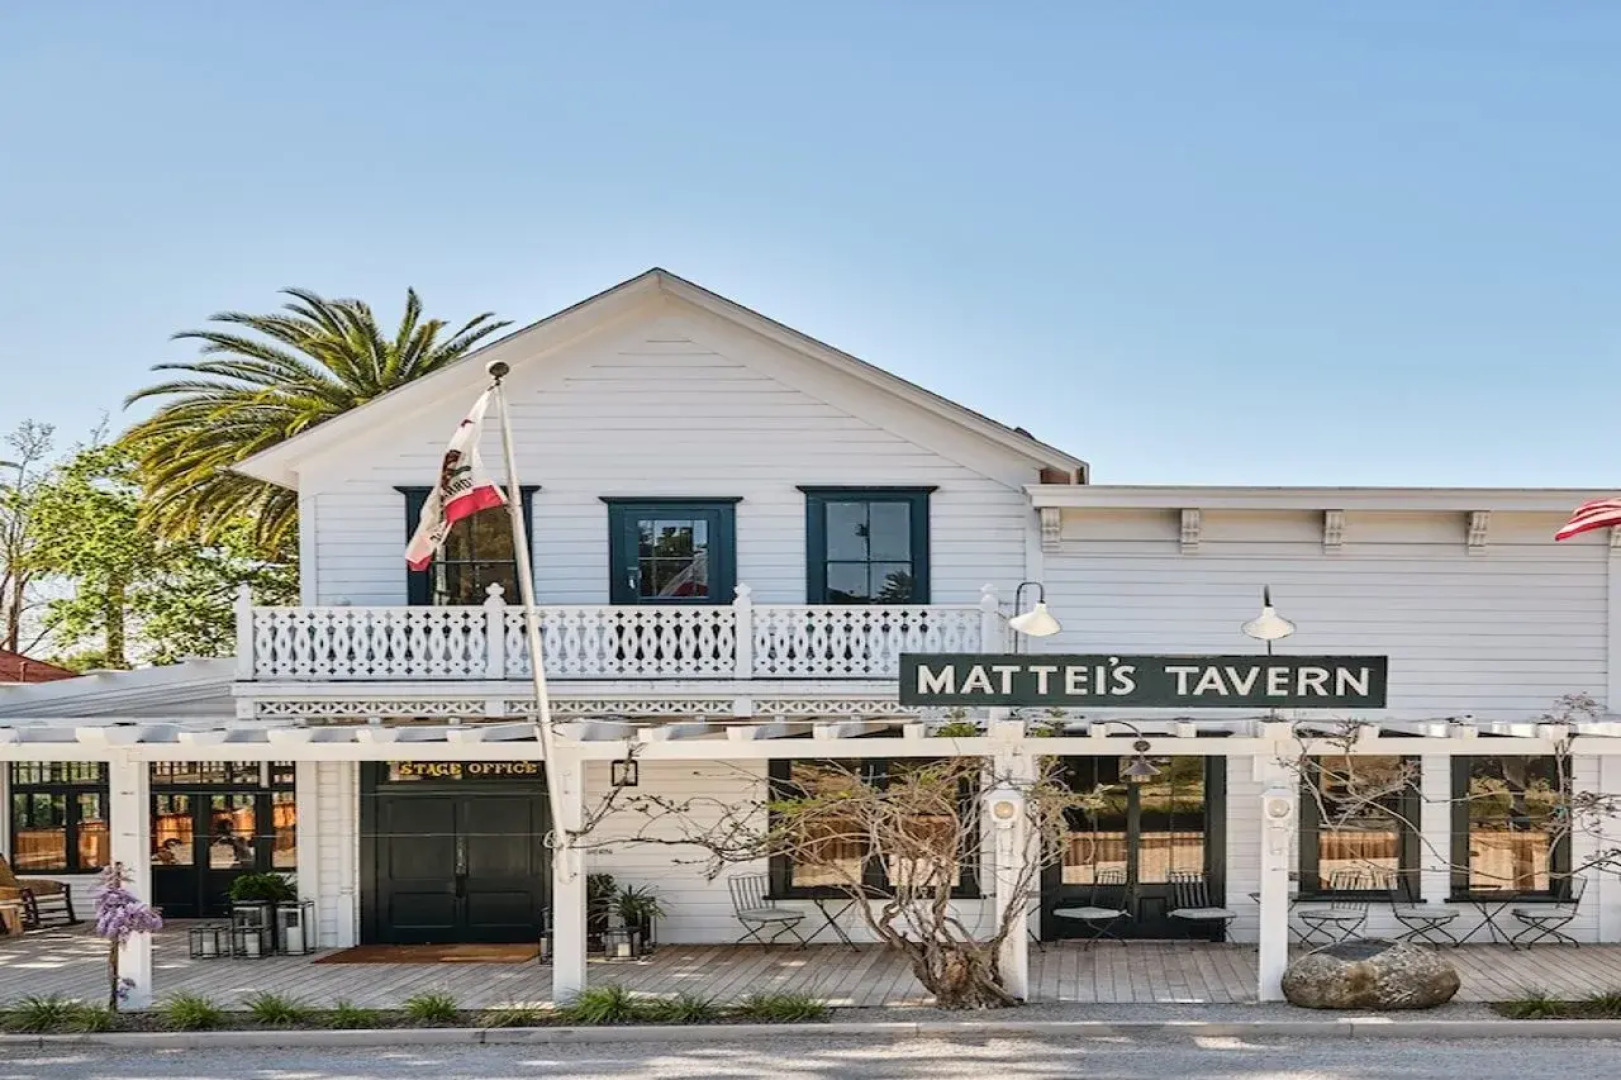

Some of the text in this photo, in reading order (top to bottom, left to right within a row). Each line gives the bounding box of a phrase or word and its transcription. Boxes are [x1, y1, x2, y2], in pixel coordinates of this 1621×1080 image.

[917, 657, 1370, 697] MATTEI'S TAVERN
[400, 761, 538, 776] STAGE OFFICE
